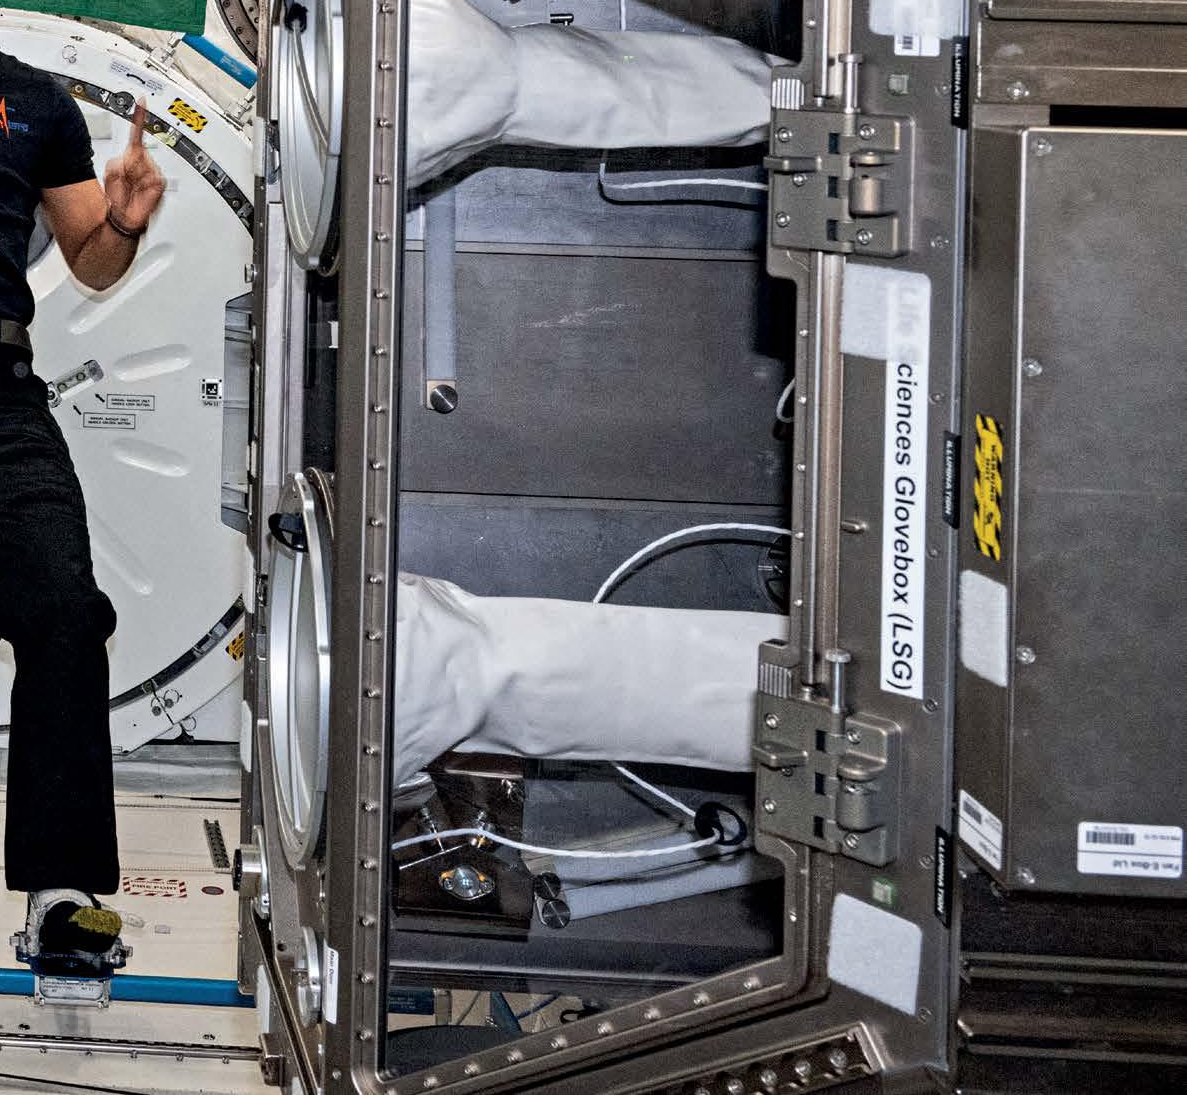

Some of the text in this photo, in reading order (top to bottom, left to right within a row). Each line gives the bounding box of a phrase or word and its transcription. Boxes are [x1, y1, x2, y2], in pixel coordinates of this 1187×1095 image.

[953, 42, 962, 118] ILLUMINATION
[895, 349, 918, 466] ciences
[944, 439, 953, 515] ILLUMINATION
[893, 475, 916, 604] Glovebox
[886, 612, 914, 691] (LSG)
[936, 836, 946, 914] ILLUMINATION
